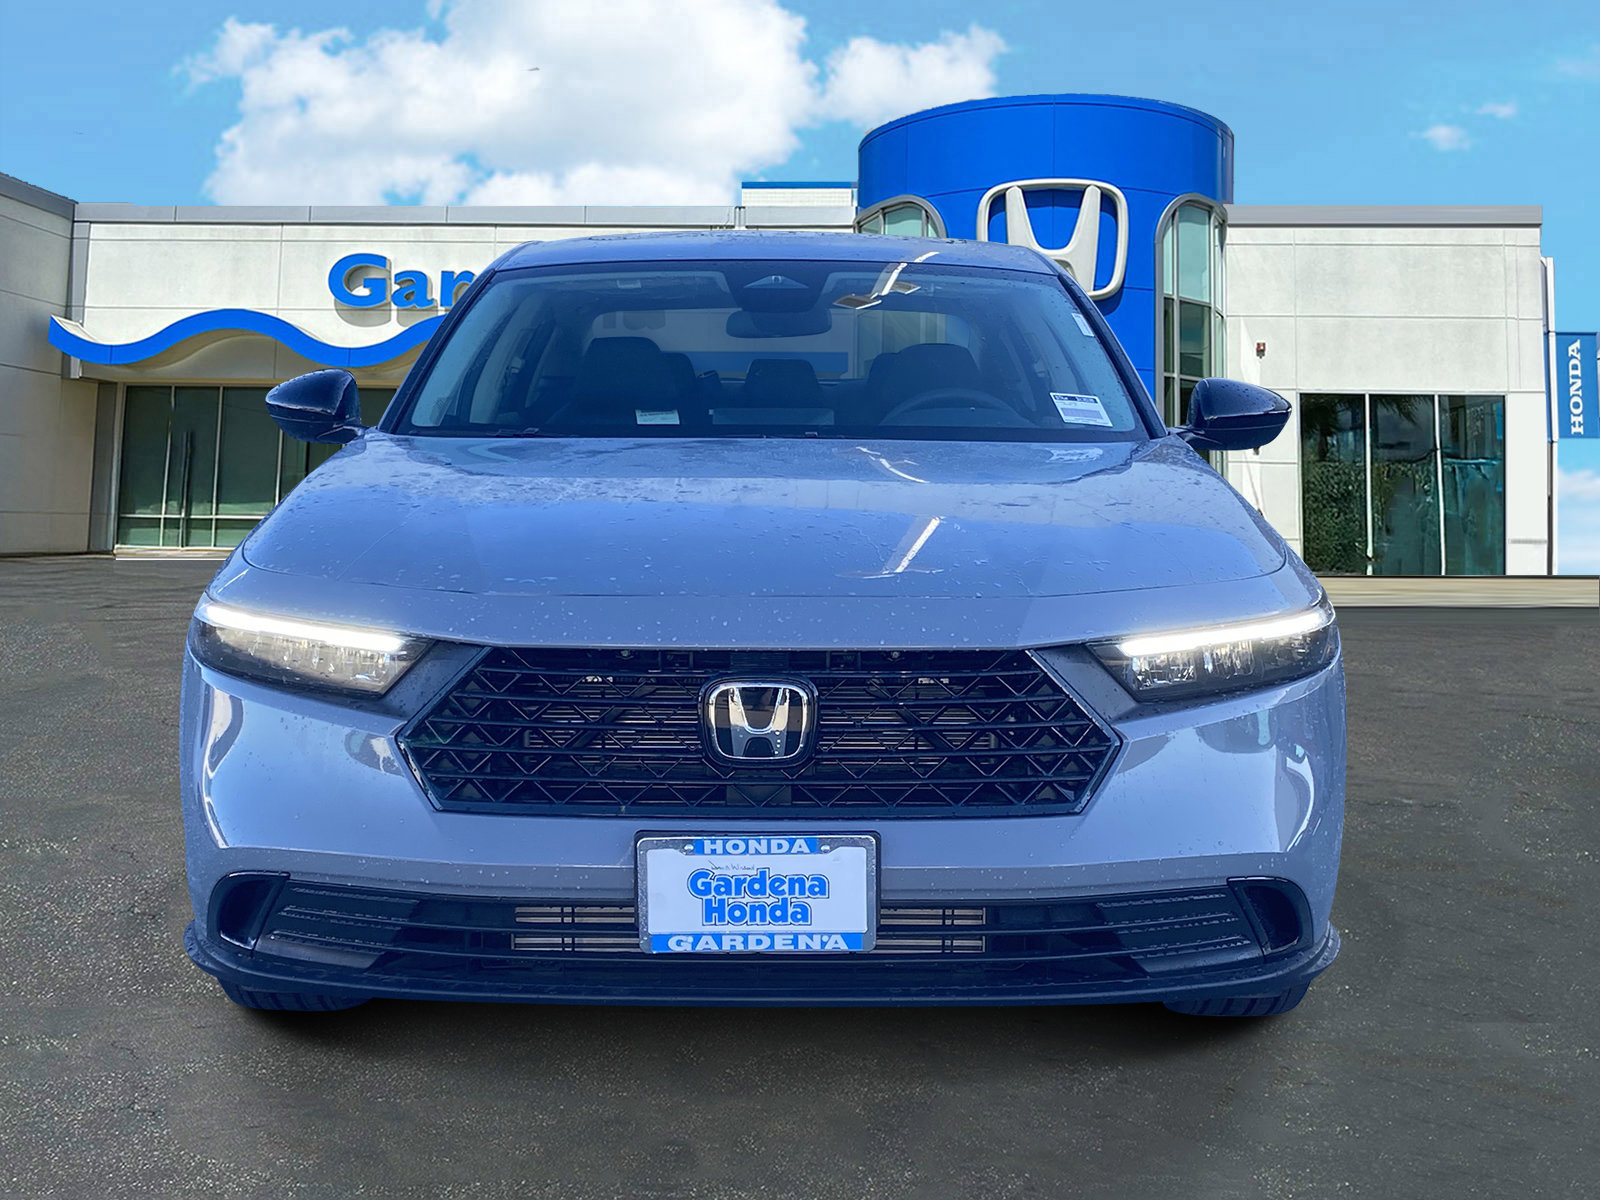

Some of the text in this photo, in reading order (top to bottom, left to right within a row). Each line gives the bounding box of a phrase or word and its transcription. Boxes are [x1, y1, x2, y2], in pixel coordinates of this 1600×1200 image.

[1567, 339, 1584, 435] HONDA
[703, 838, 811, 855] HONDA
[688, 868, 829, 898] Gardena
[703, 898, 811, 924] Honda
[667, 934, 849, 951] GARDENA
